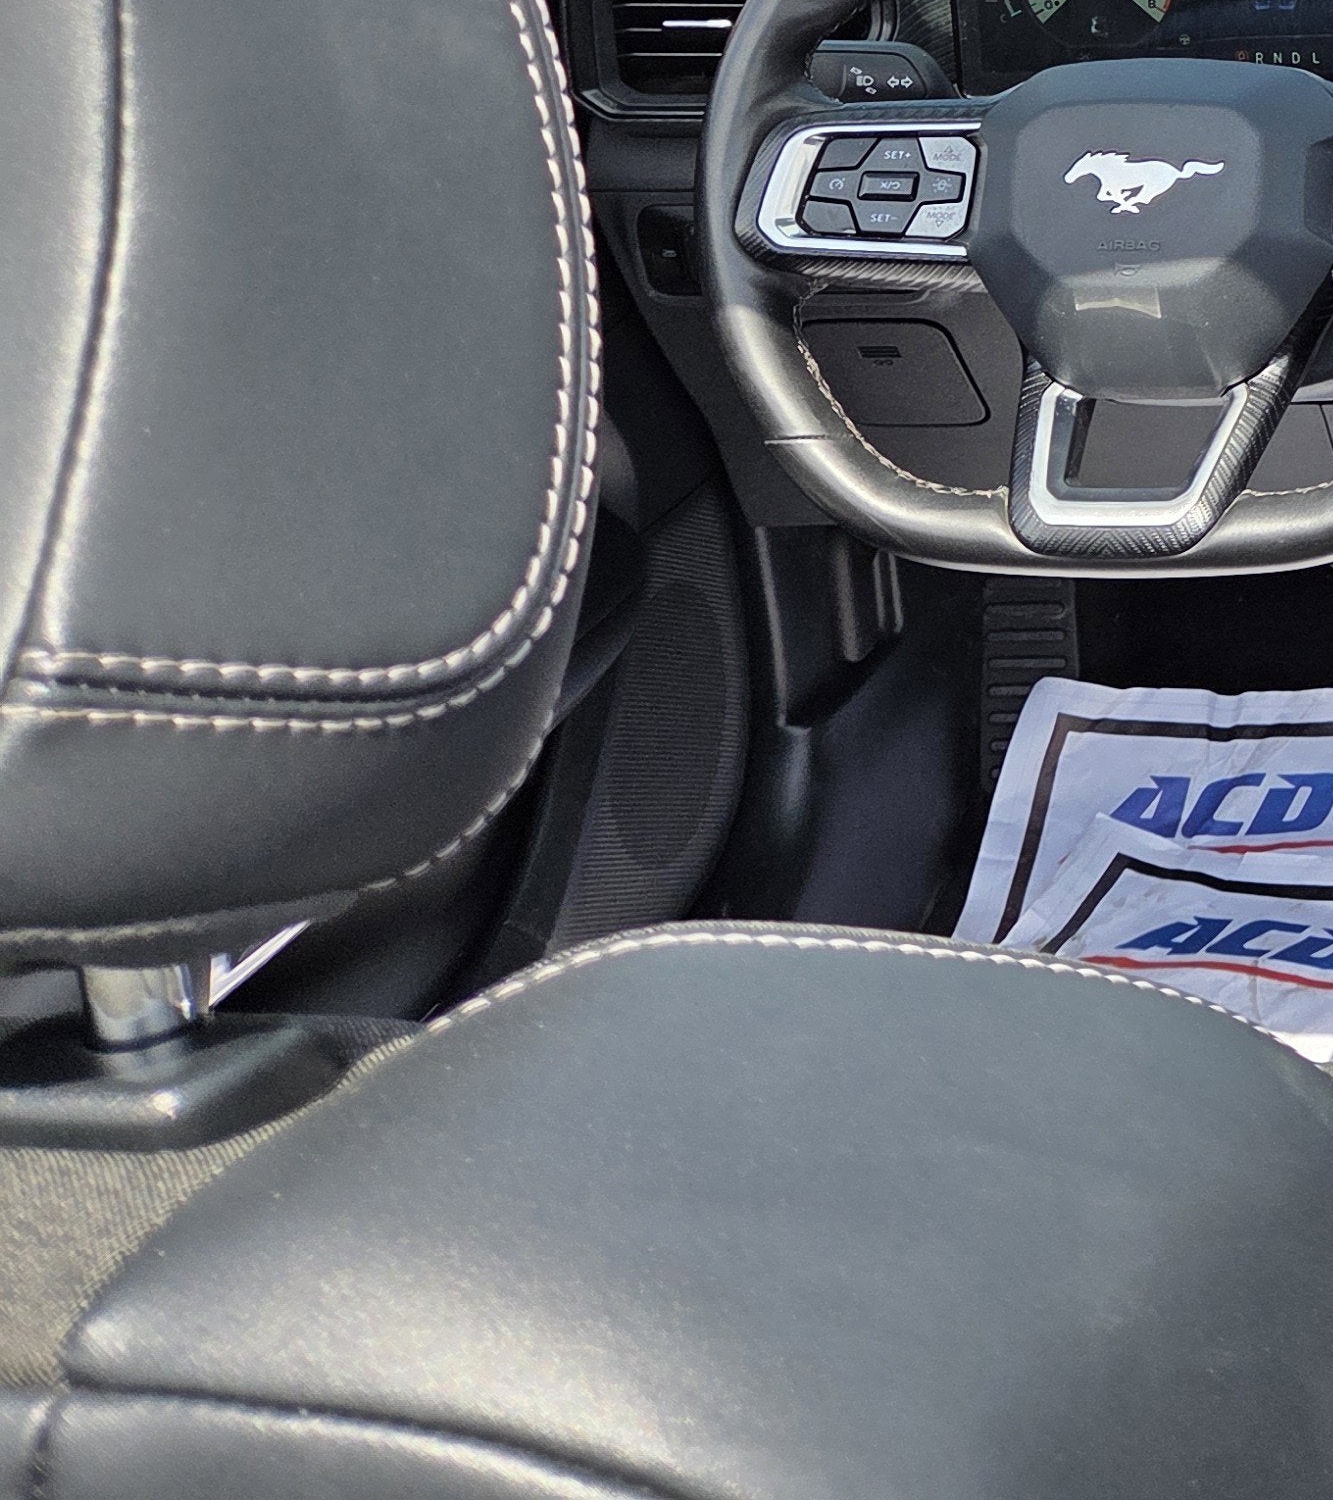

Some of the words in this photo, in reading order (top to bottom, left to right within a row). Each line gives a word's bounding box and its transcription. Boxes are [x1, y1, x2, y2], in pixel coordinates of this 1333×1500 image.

[1273, 52, 1283, 64] N
[1291, 52, 1302, 64] D
[1312, 52, 1321, 65] L
[883, 150, 911, 160] SET+
[932, 152, 964, 162] MODE
[925, 210, 956, 221] MODE
[1097, 239, 1160, 251] AIRBAG
